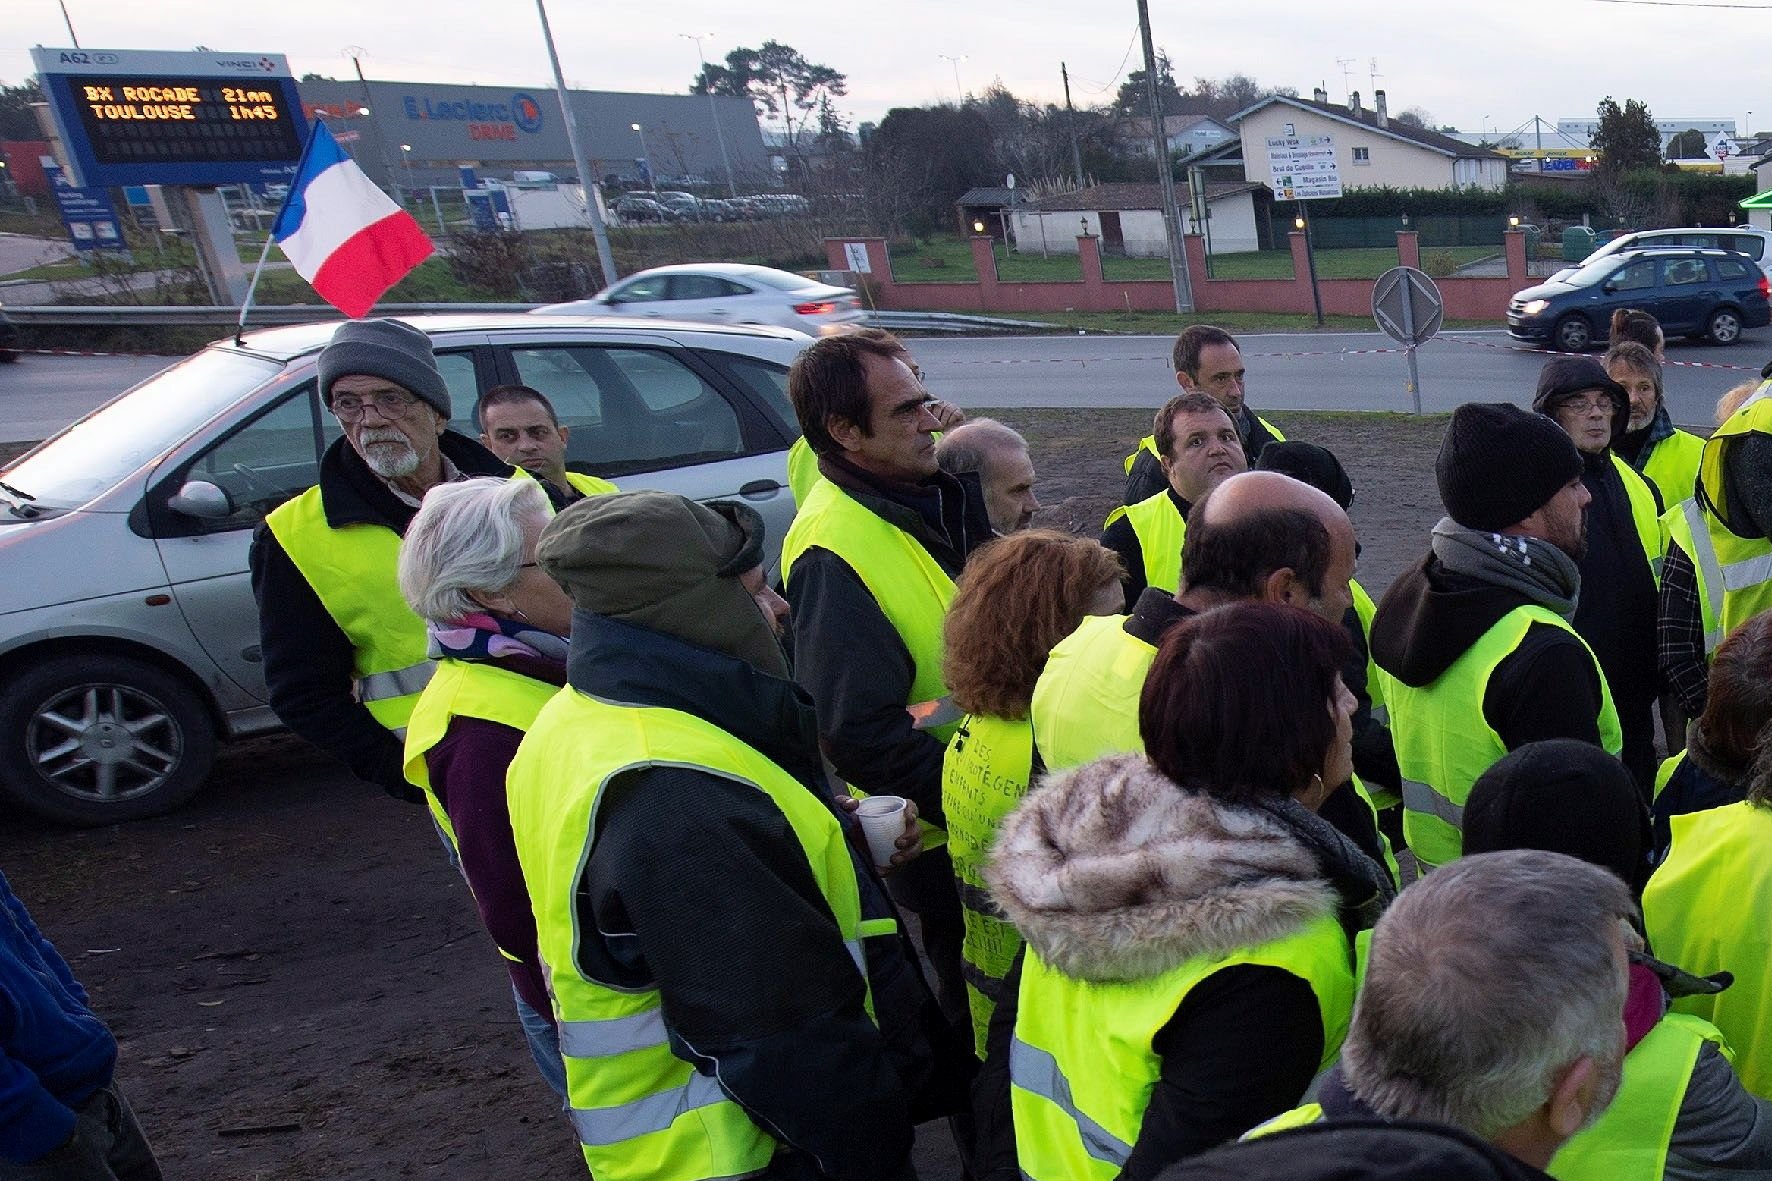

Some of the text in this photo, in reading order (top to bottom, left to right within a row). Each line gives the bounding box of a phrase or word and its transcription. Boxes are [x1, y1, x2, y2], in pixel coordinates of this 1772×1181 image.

[60, 52, 91, 64] A62
[123, 86, 200, 102] ROCADE
[90, 104, 277, 120] TOULOUSE 1h45
[403, 95, 512, 121] E.Leclerc
[467, 122, 518, 141] DRIVE
